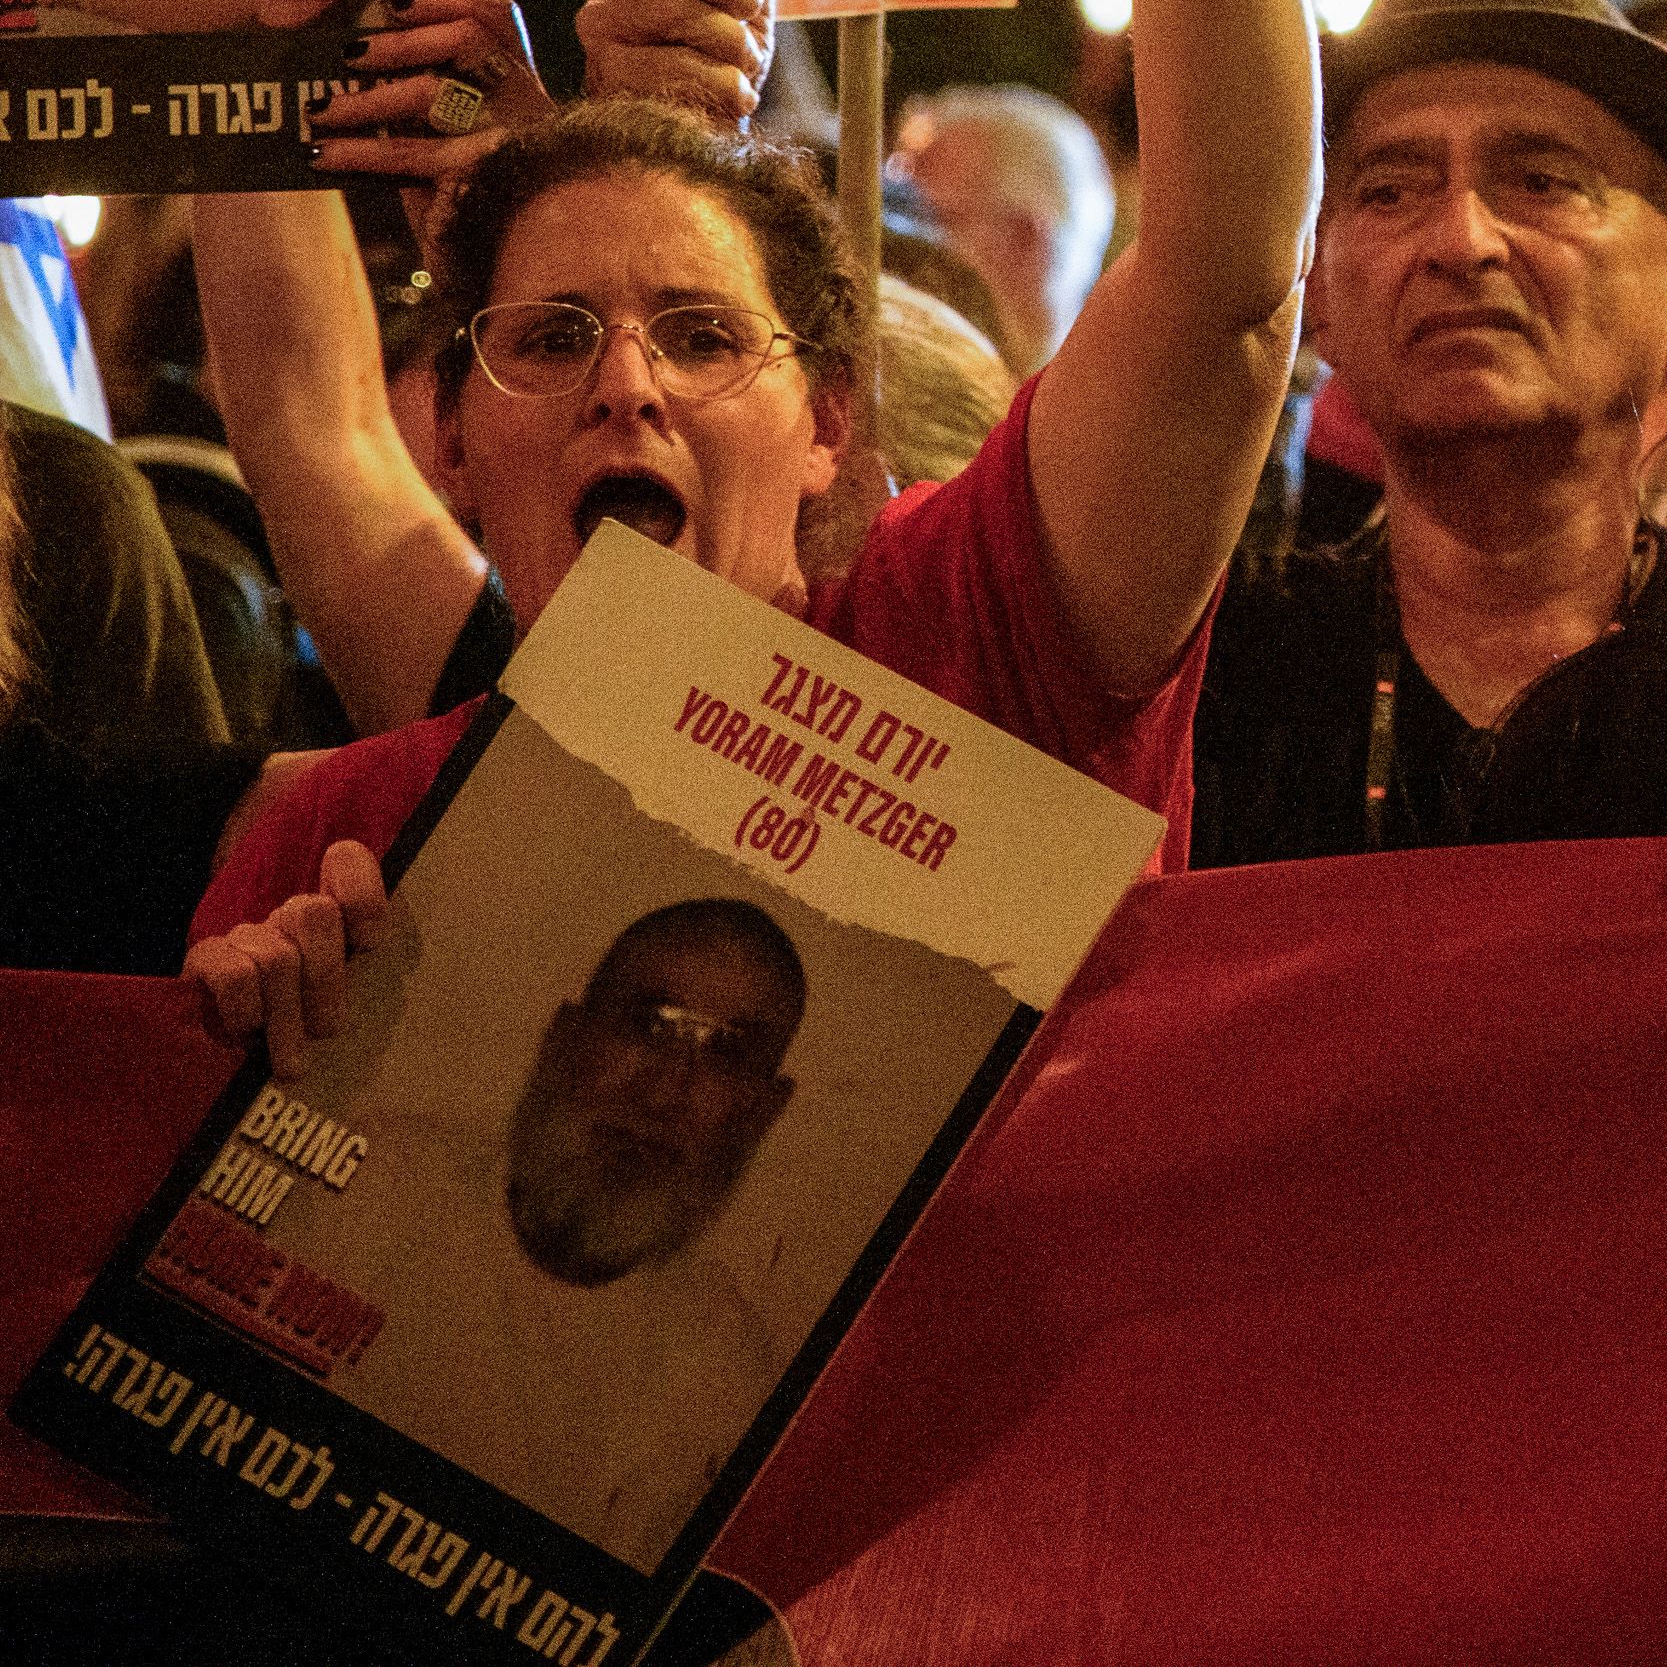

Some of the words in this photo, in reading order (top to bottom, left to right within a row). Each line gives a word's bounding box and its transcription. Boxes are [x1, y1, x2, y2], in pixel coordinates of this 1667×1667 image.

[27, 78, 114, 140] לכם
[168, 81, 283, 136] פגרה
[760, 651, 863, 744] מצגר
[673, 685, 805, 787] YORAM
[791, 753, 958, 872] METZGER
[854, 709, 951, 784] יורם
[734, 795, 822, 874] (80)
[240, 1084, 370, 1190] BRING
[201, 1144, 296, 1226] HIM
[62, 1323, 195, 1429] פגרה!
[169, 1391, 256, 1456] אין
[239, 1425, 335, 1511] לכם
[349, 1491, 470, 1590] פגרה
[445, 1551, 533, 1628] אין
[516, 1589, 621, 1667] להם
